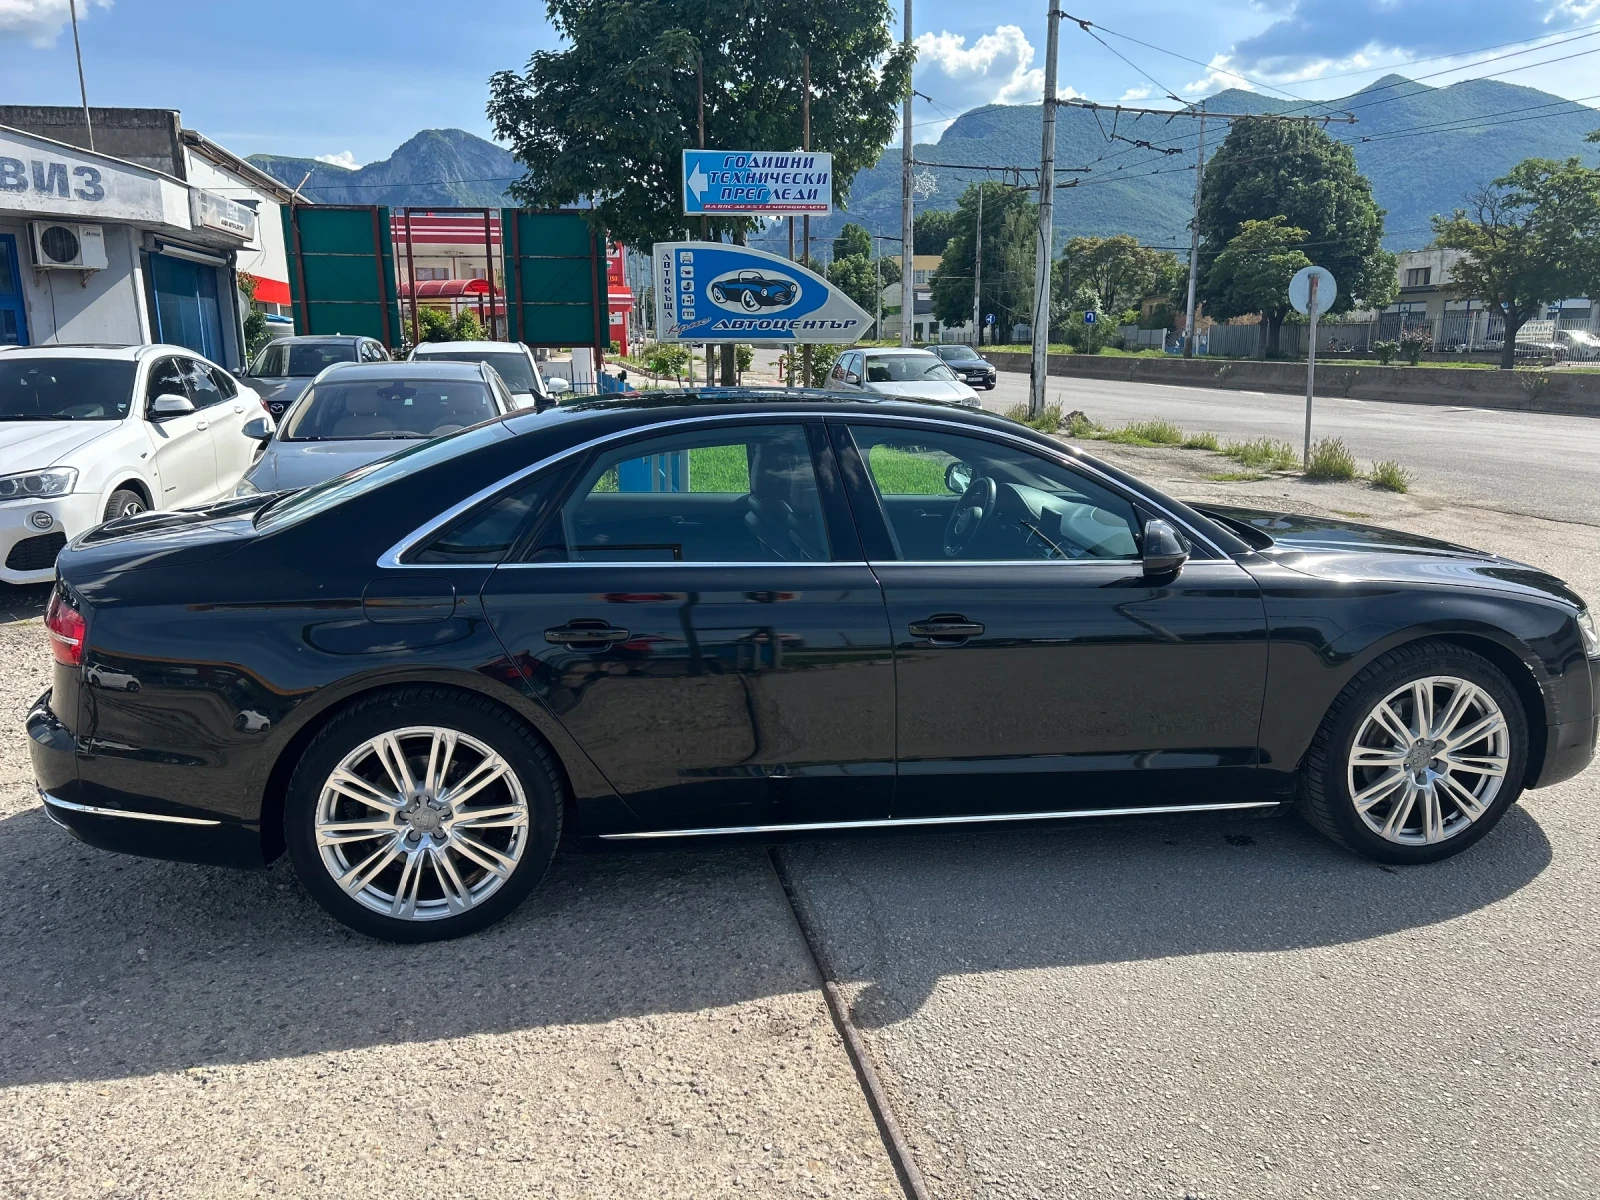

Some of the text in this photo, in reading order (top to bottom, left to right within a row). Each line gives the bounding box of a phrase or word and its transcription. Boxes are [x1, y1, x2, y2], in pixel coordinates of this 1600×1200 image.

[723, 156, 815, 169] ГОДИШНИ
[709, 172, 828, 185] ТЕХНИЧЕСКИ
[720, 187, 819, 200] ПРЕГЛЕДИ
[662, 253, 674, 318] АВТОКЪЩА
[712, 319, 858, 330] АВТОЦЕНТЪР
